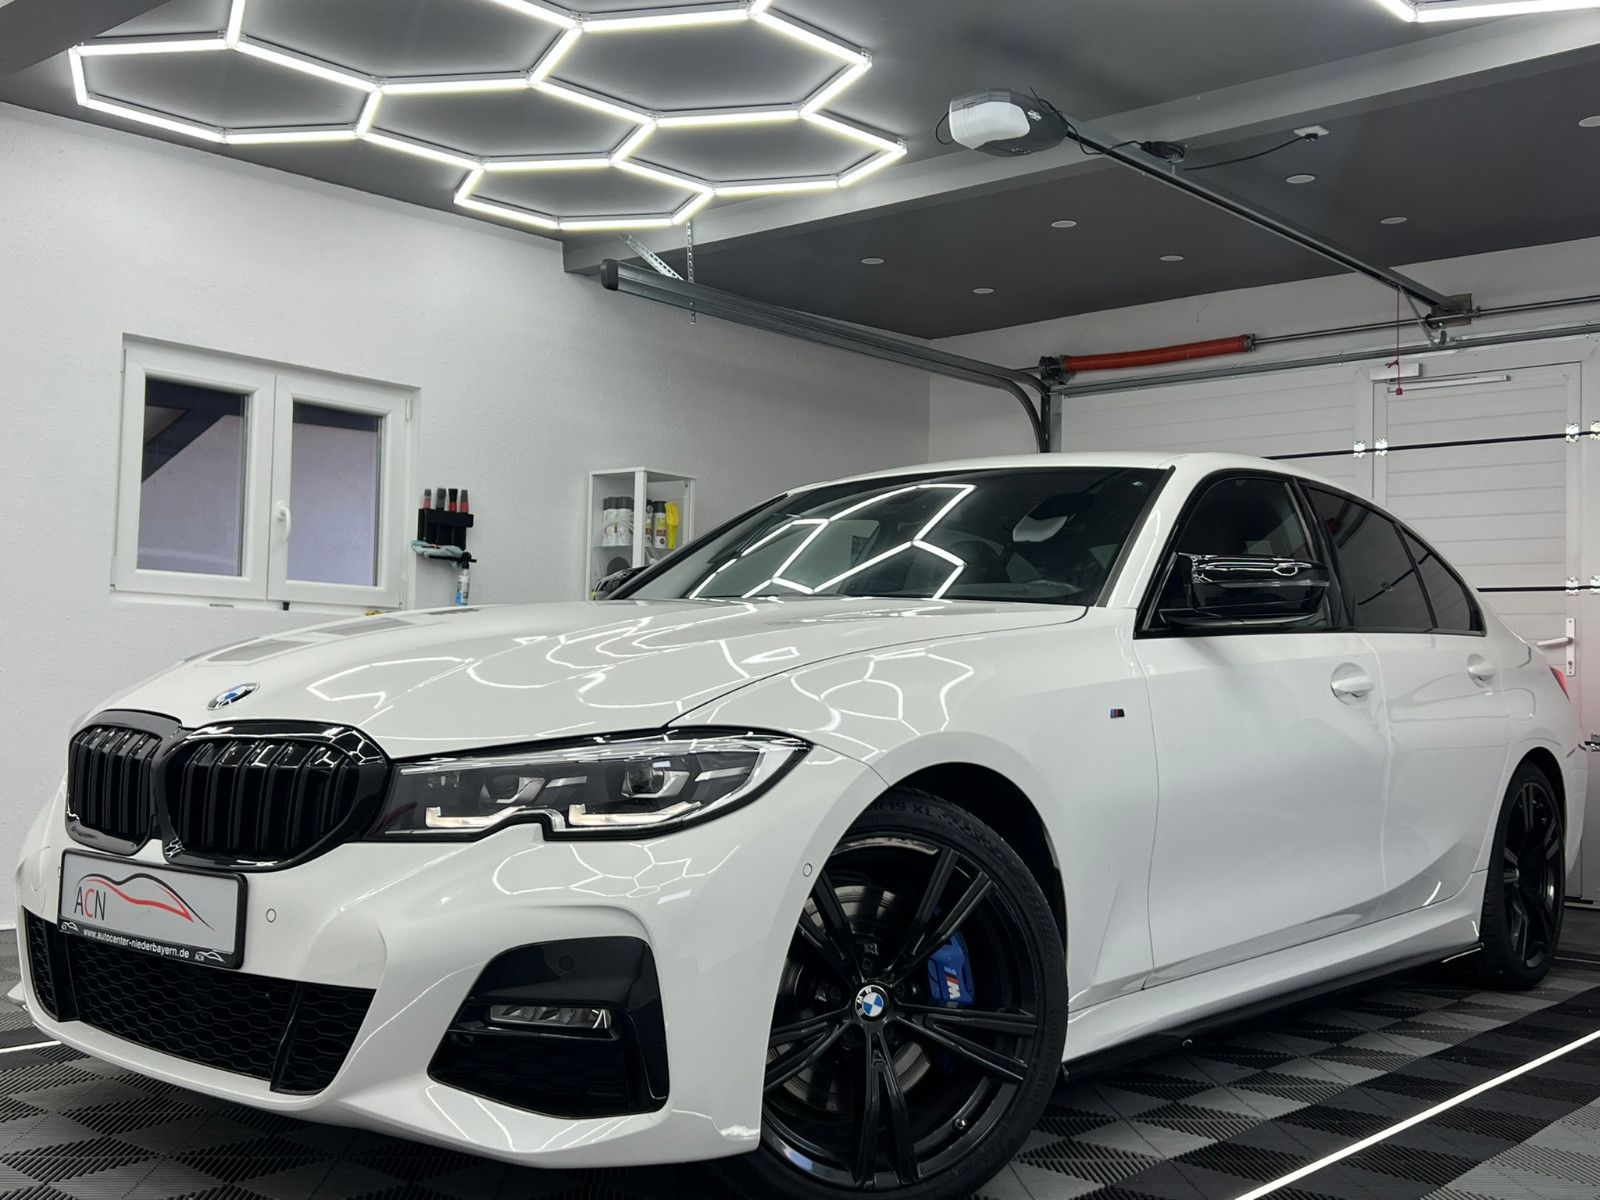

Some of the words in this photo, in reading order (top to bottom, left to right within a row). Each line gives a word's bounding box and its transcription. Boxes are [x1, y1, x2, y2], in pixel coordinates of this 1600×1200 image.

[889, 799, 907, 812] 19
[912, 803, 934, 818] XL
[74, 886, 107, 921] ACN
[83, 928, 190, 959] www.autocenter-niederbayern.de
